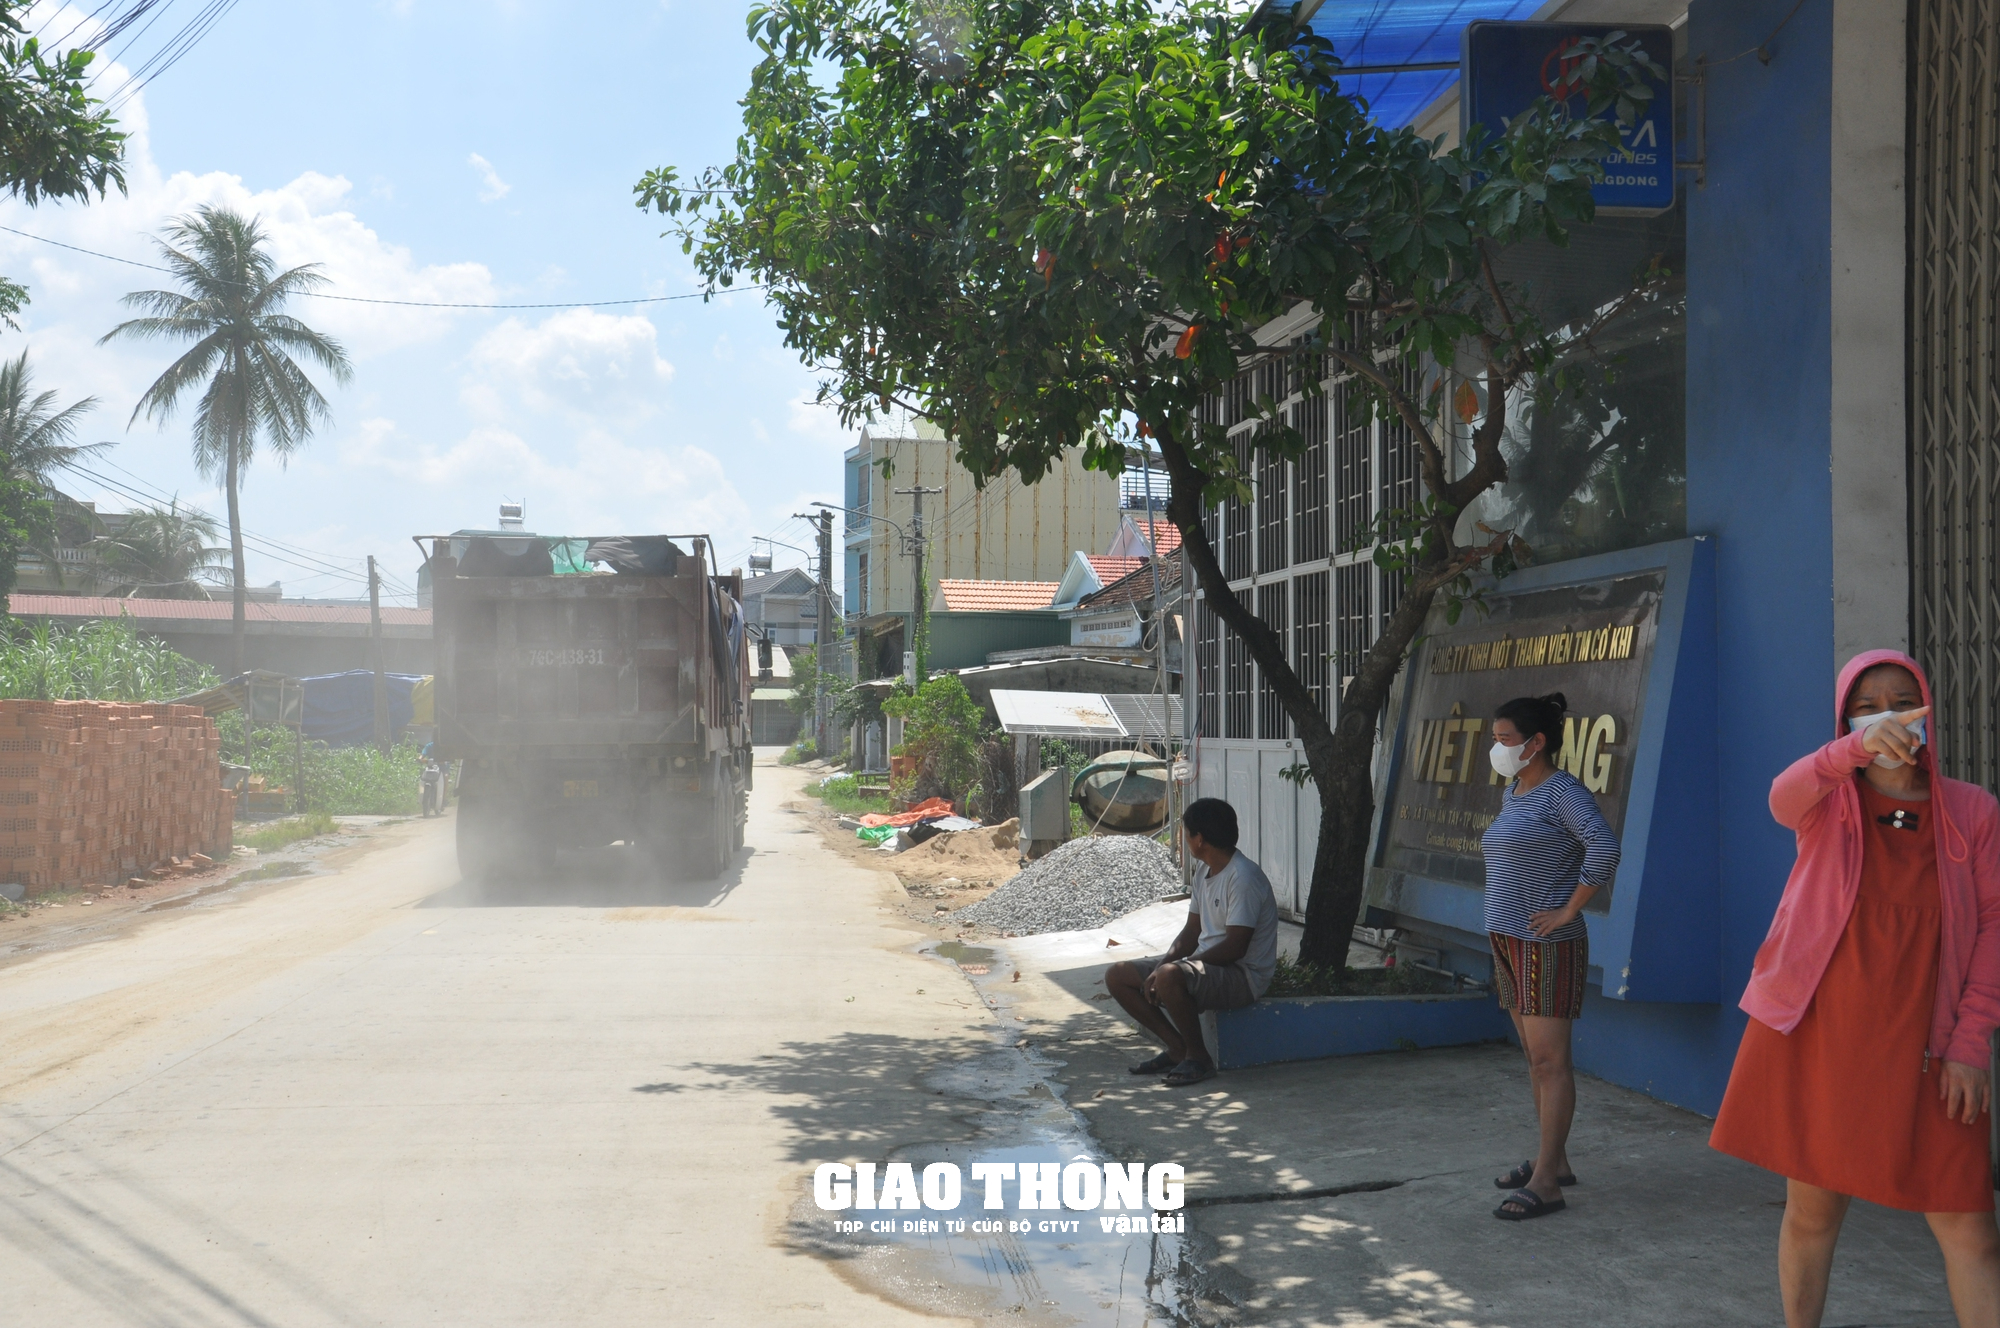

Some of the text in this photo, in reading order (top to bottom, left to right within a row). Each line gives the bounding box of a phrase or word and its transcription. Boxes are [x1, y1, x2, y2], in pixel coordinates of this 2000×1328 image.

[1452, 644, 1467, 673] TY
[1466, 641, 1491, 672] TNHH
[1513, 634, 1548, 668] THANH
[1573, 630, 1592, 662] TM
[1413, 701, 1482, 799] VIỆT
